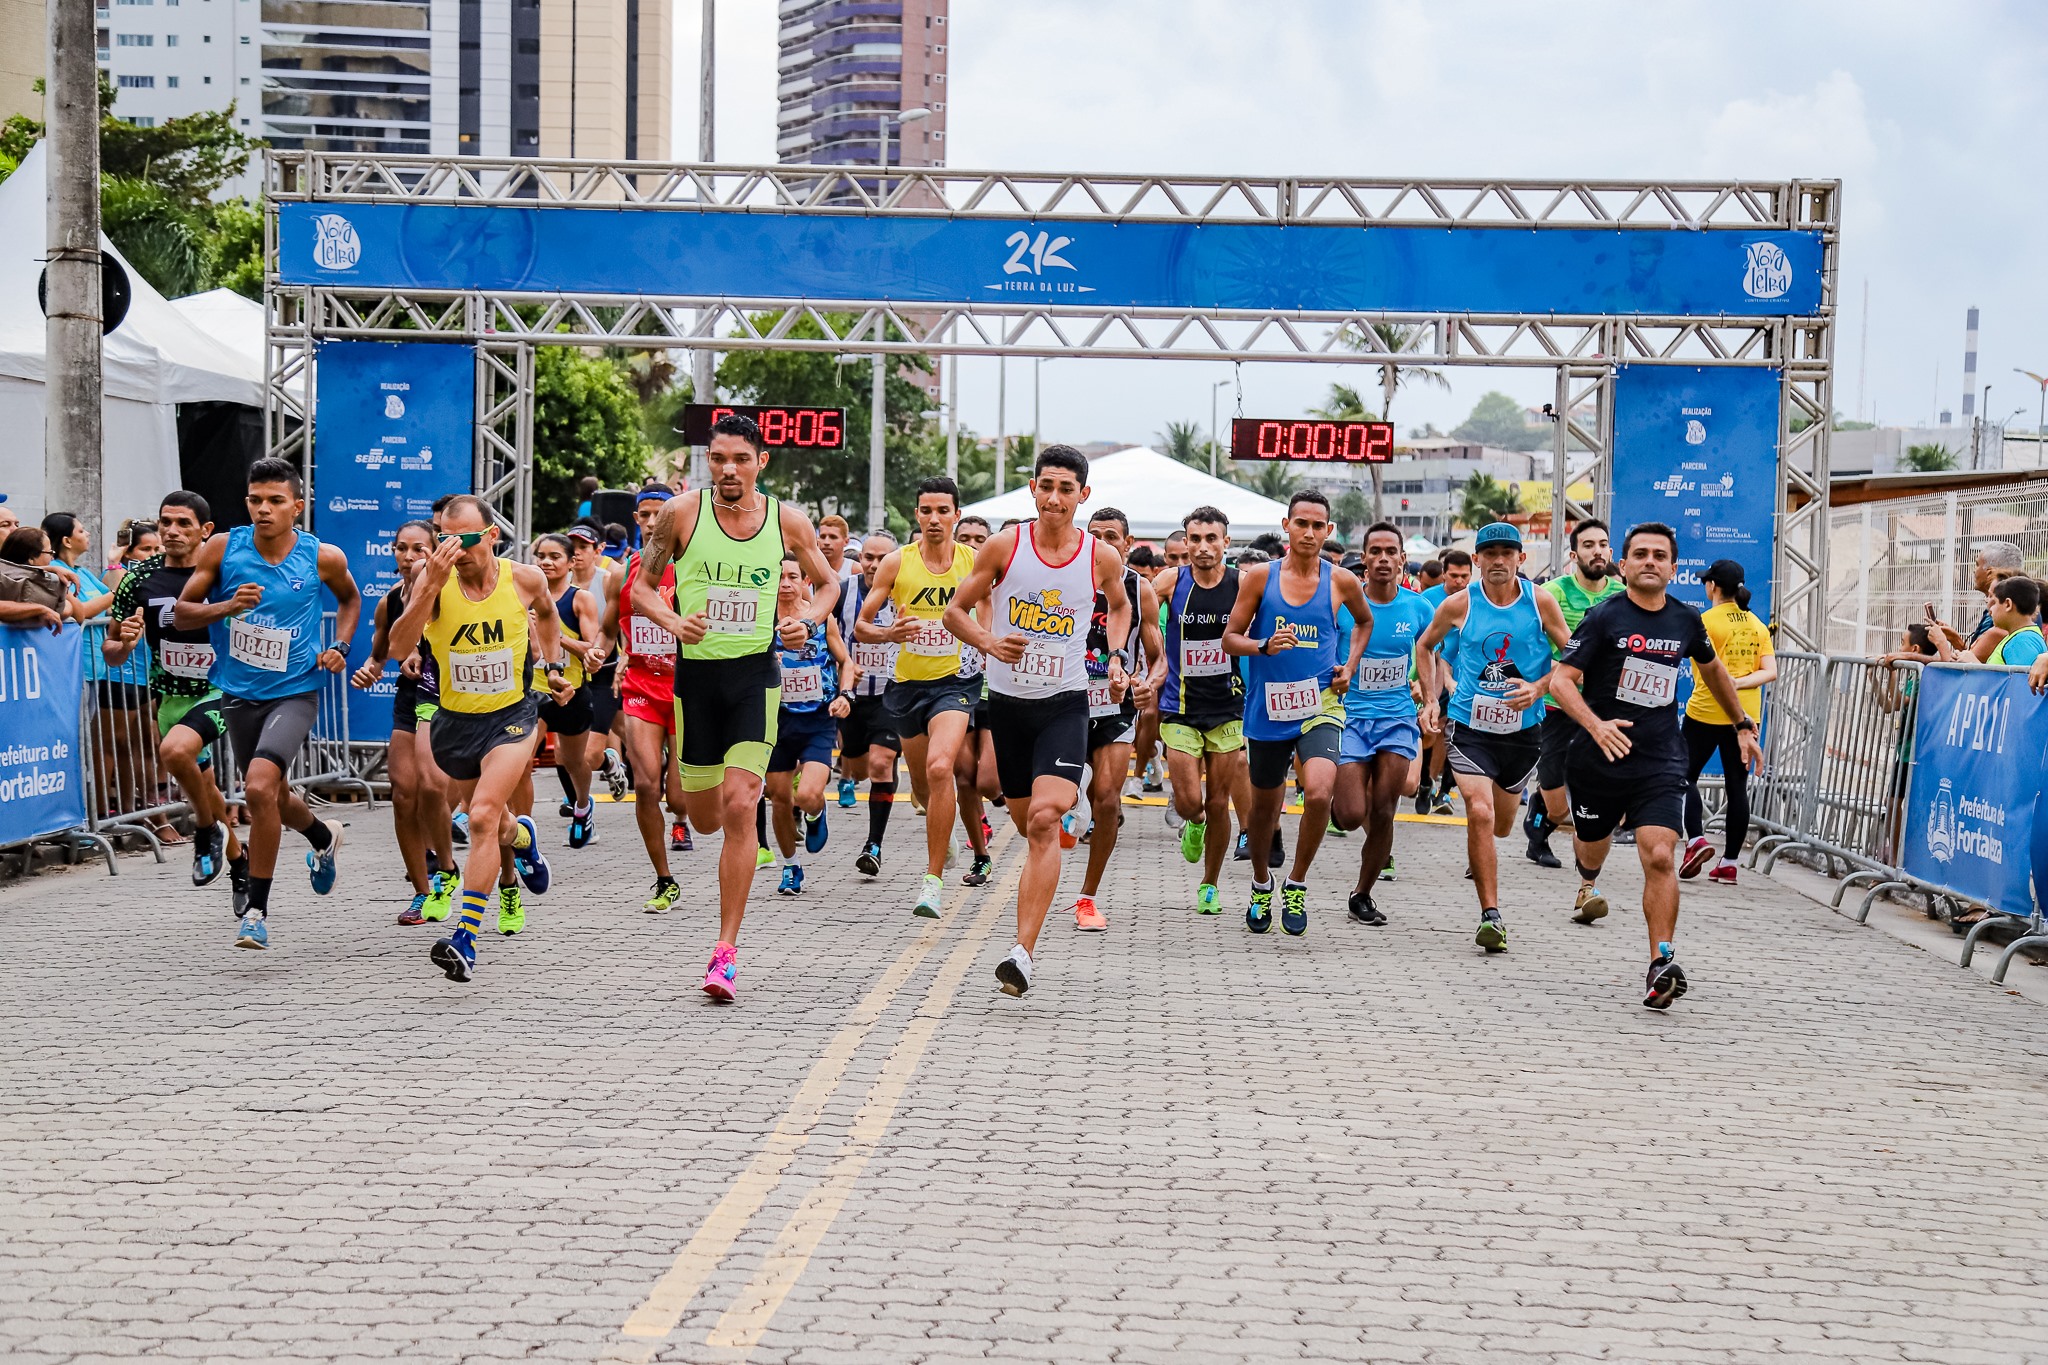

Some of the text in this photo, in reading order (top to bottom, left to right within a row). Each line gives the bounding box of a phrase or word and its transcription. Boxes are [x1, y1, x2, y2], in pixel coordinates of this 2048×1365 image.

[1003, 231, 1078, 275] 21K
[1005, 281, 1075, 292] TERRA DA LUZ
[1681, 407, 1712, 416] REALIZAÇÃO
[381, 436, 407, 444] PARCERIA
[1257, 422, 1391, 460] 0:00:02
[355, 454, 396, 464] SEBRAE
[1681, 462, 1707, 470] PARCERIA
[385, 481, 402, 489] APOIO
[1653, 481, 1696, 491] SEBRAE
[347, 503, 379, 511] Fortaleza
[1684, 508, 1701, 516] APOIO
[708, 600, 755, 621] 0910
[1009, 596, 1075, 637] Vilton
[1726, 612, 1748, 622] STAFF
[636, 627, 672, 644] 1305
[911, 630, 953, 646] 553
[235, 632, 282, 660] 0848
[167, 651, 213, 669] 1022
[1014, 653, 1062, 678] 0831
[1189, 650, 1224, 666] 1227
[458, 663, 506, 682] 0919
[1365, 665, 1404, 682] 0295
[1623, 670, 1667, 698] 0743
[1272, 689, 1315, 710] 1648
[1478, 705, 1517, 724] 1635
[52, 739, 68, 759] de
[0, 766, 66, 802] ortaleza
[1958, 795, 2005, 827] Prefeitura de
[1956, 822, 2003, 865] Fortaleza
